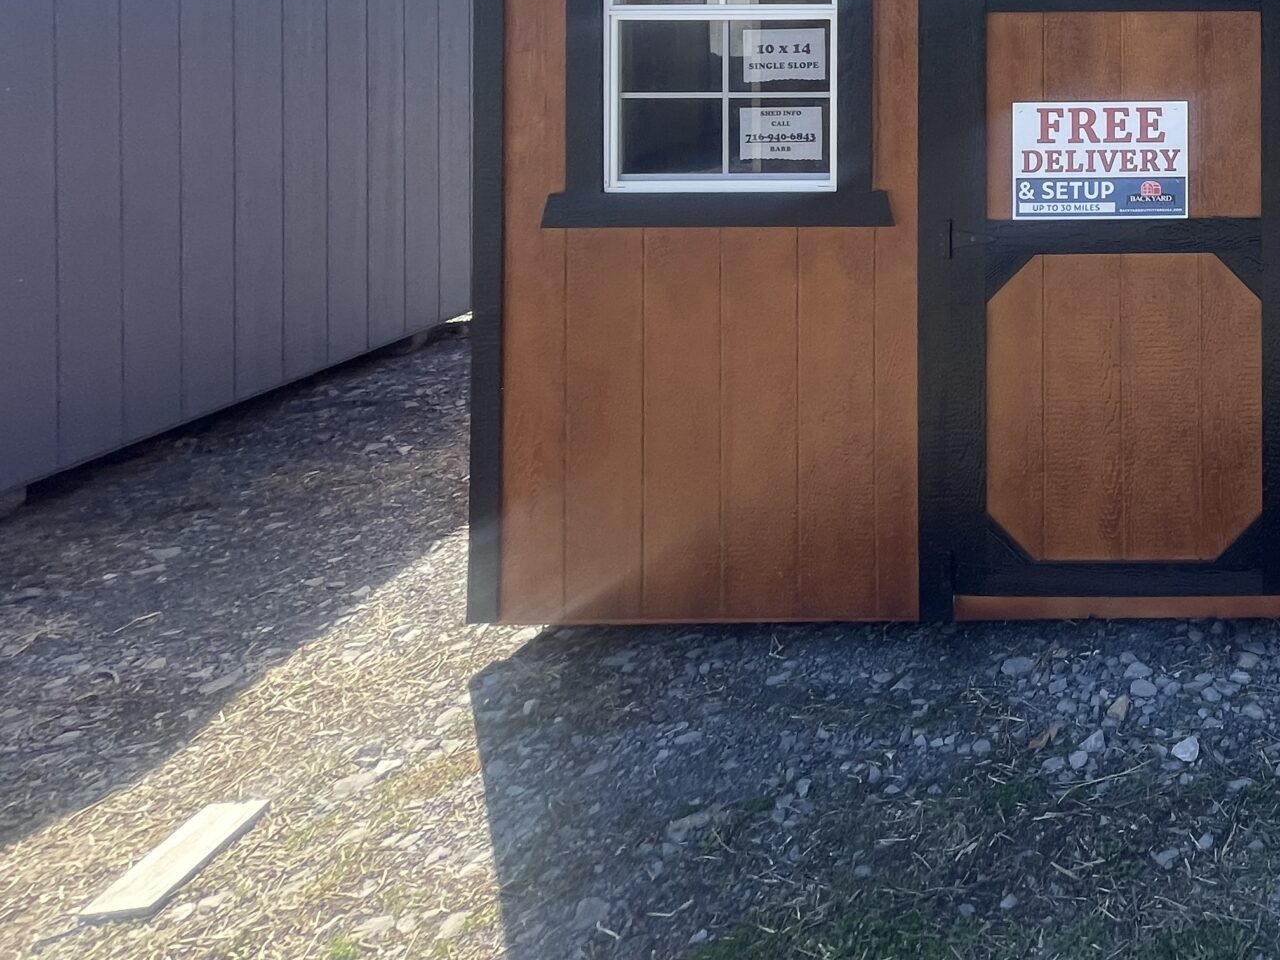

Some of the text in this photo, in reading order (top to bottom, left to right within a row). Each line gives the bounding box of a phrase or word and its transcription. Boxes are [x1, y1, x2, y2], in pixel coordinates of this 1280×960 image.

[756, 43, 811, 54] 10 x 14
[748, 61, 819, 70] SINGLE SLOPE
[1036, 106, 1166, 144] FREE
[745, 132, 817, 143] 716-940-6843
[1021, 149, 1181, 174] DELIVERY
[1018, 181, 1115, 200] & SETUP
[1032, 204, 1101, 212] UP TO 30 MILES
